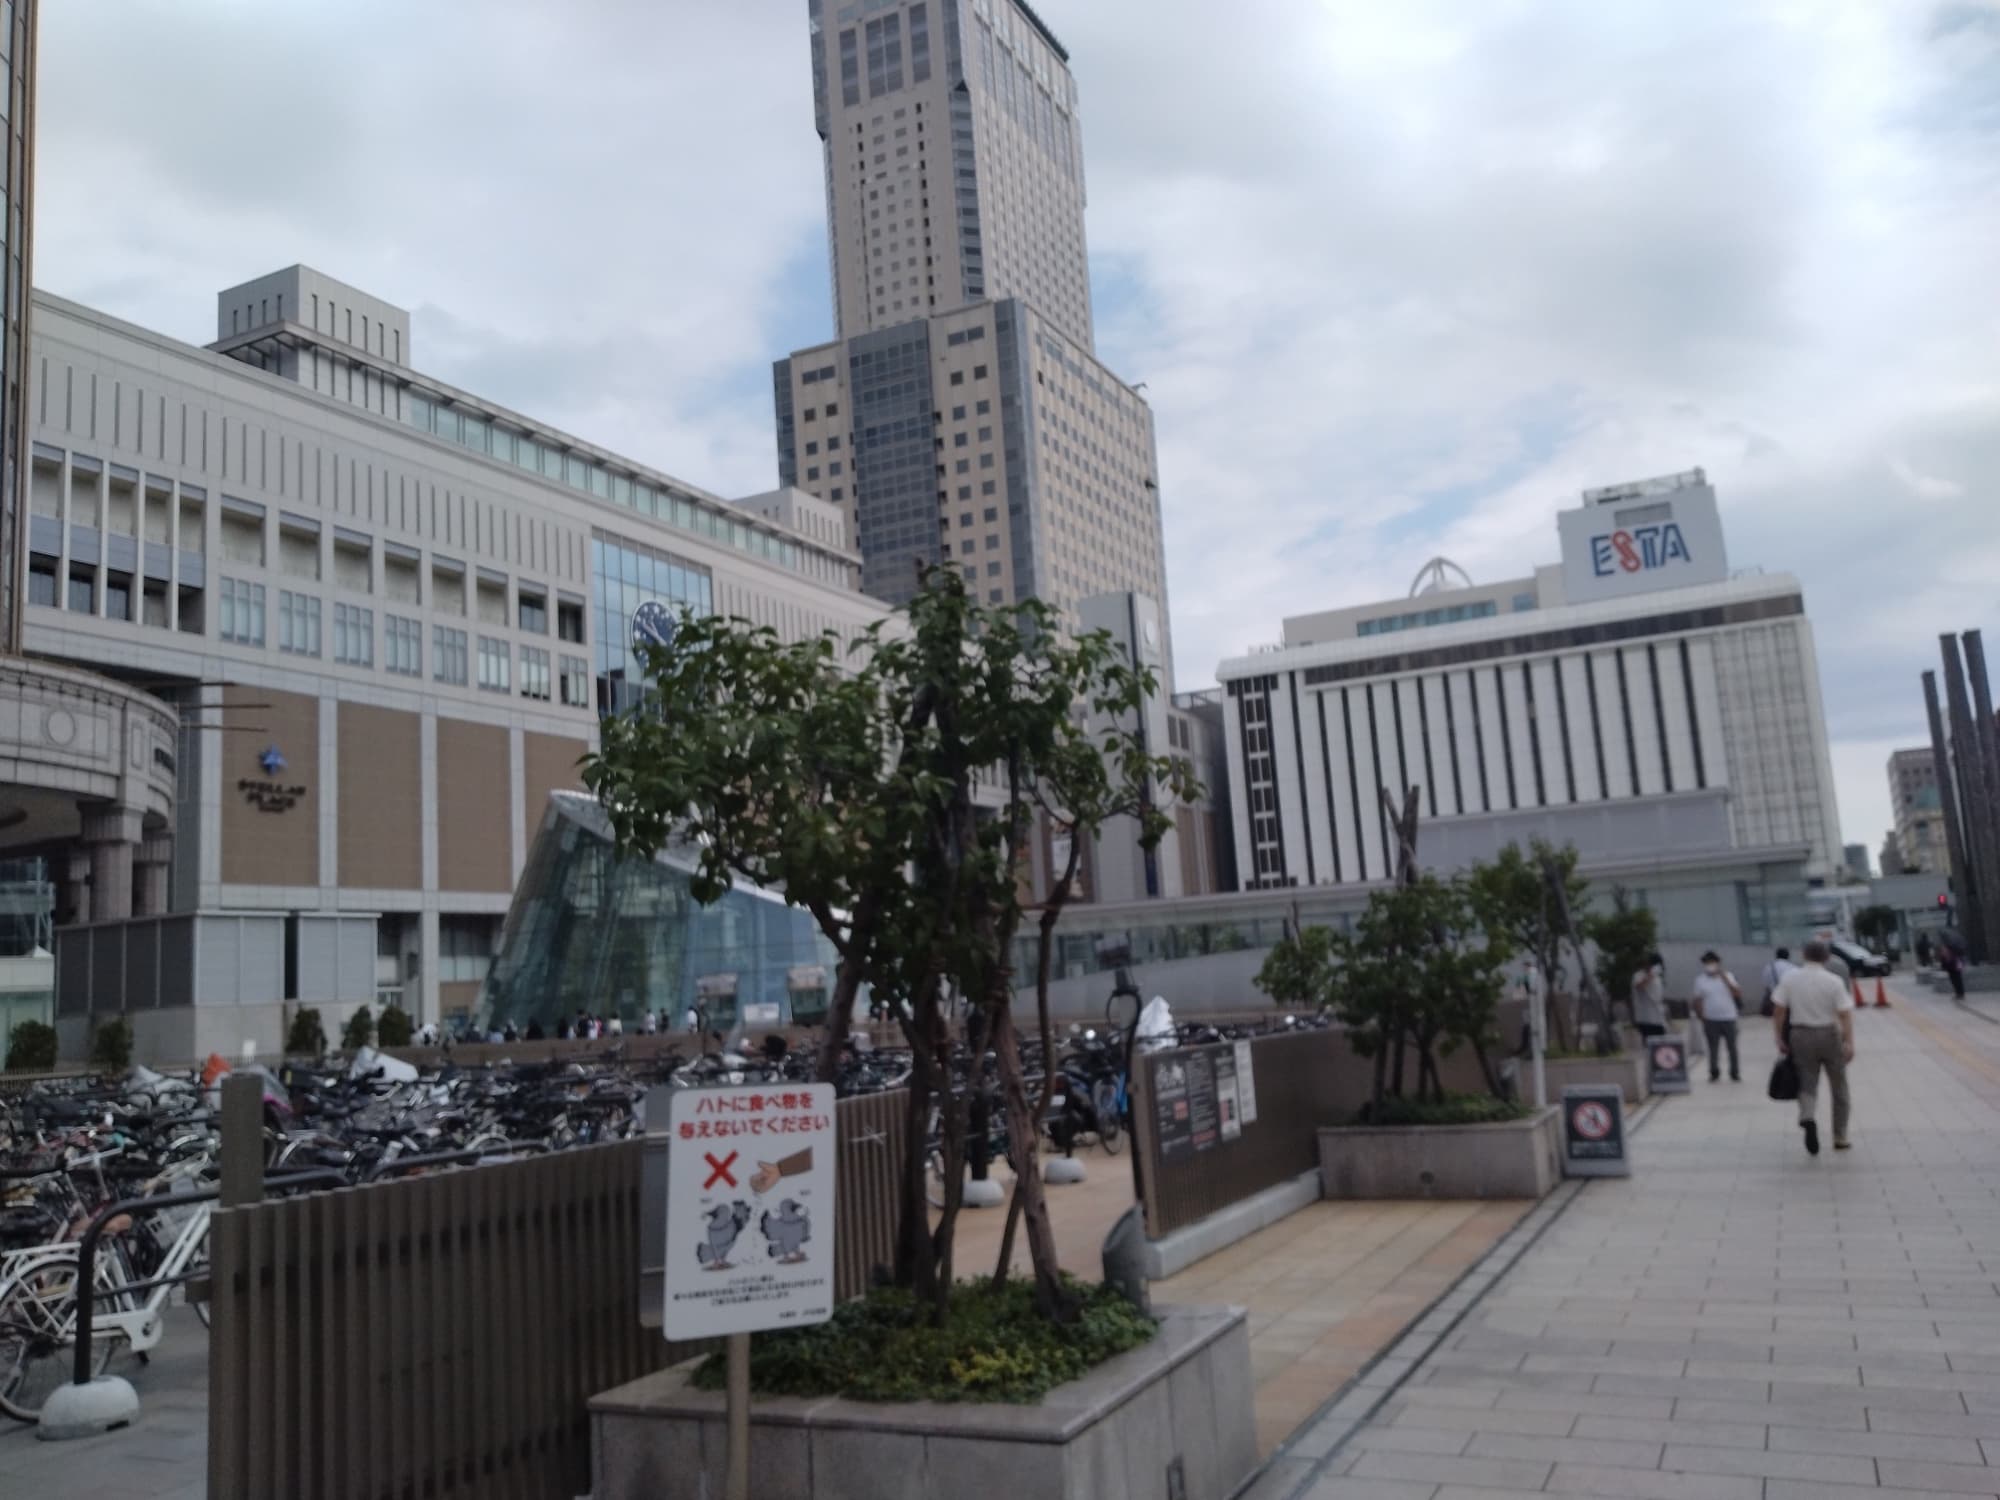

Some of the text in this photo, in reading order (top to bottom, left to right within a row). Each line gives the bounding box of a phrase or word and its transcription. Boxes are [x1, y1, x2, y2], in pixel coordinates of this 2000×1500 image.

[1590, 523, 1691, 577] ESTA
[696, 1092, 813, 1114] ハトに食べ物を
[679, 1115, 830, 1140] 与えないでください
